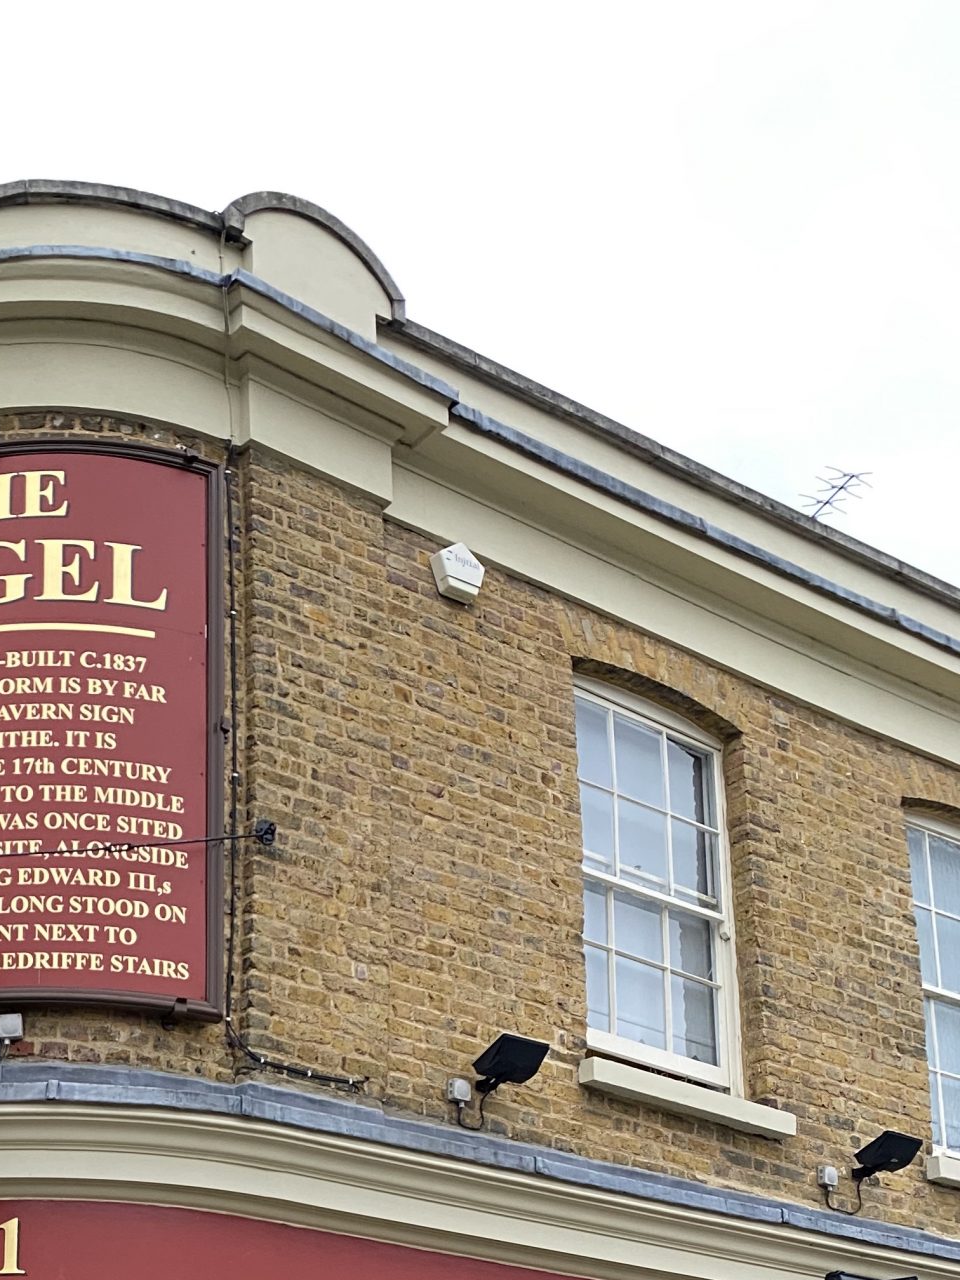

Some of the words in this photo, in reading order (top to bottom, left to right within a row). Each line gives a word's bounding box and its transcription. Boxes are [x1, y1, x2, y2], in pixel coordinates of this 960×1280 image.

[79, 651, 147, 673] C.1837
[59, 677, 81, 694] IS
[86, 678, 118, 696] BY
[123, 681, 167, 703] FAR
[79, 703, 135, 725] SIGN
[65, 730, 90, 747] IT
[95, 732, 117, 749] IS
[12, 757, 55, 775] 17th
[60, 758, 172, 784] CENTURY
[1, 785, 34, 803] TO
[39, 785, 87, 803] THE
[94, 786, 185, 814] MIDDLE
[44, 812, 111, 831] ONCE
[116, 815, 183, 840] SITED
[53, 840, 189, 869] ALONGSIDE
[17, 867, 121, 887] EDWARD
[69, 896, 150, 918] STOOD
[154, 903, 187, 924] ON
[33, 924, 99, 942] NEXT
[104, 926, 137, 945] TO
[110, 954, 189, 980] STAIRS
